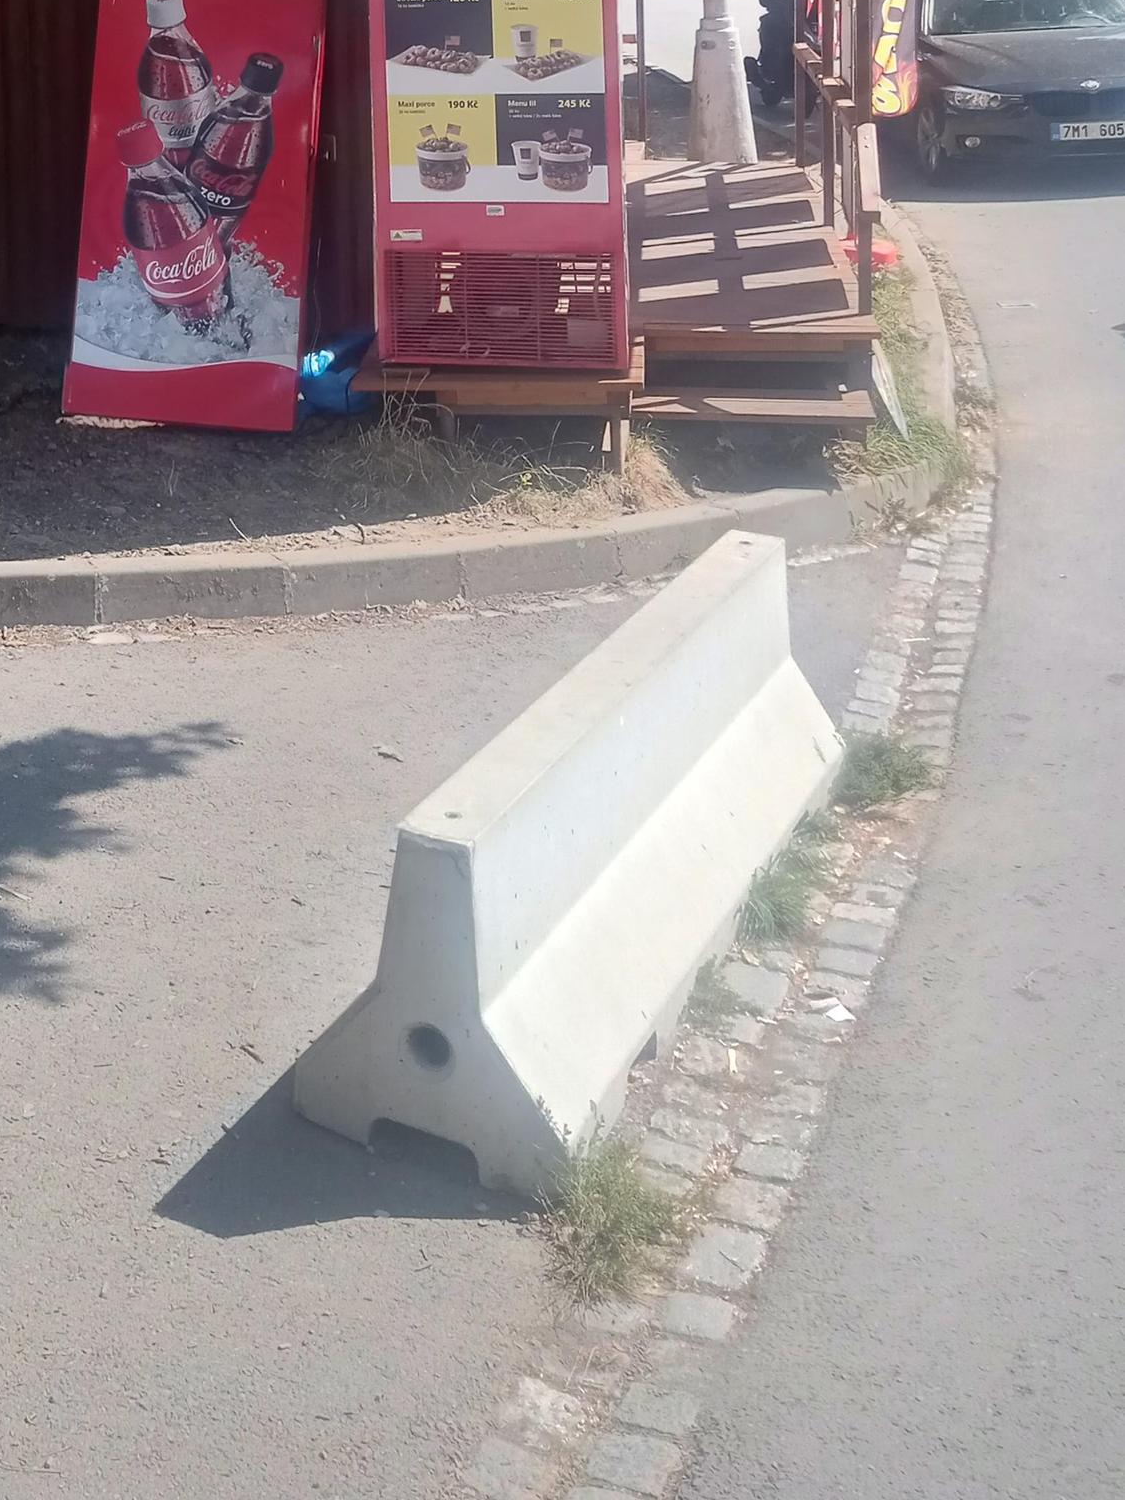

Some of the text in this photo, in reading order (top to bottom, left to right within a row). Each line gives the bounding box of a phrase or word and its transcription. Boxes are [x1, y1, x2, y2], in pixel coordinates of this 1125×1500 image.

[447, 100, 466, 109] 190
[466, 99, 479, 109] Kč
[558, 100, 577, 108] 245
[579, 99, 592, 108] Kč
[1062, 123, 1125, 138] 7M1 605
[200, 186, 232, 206] zero
